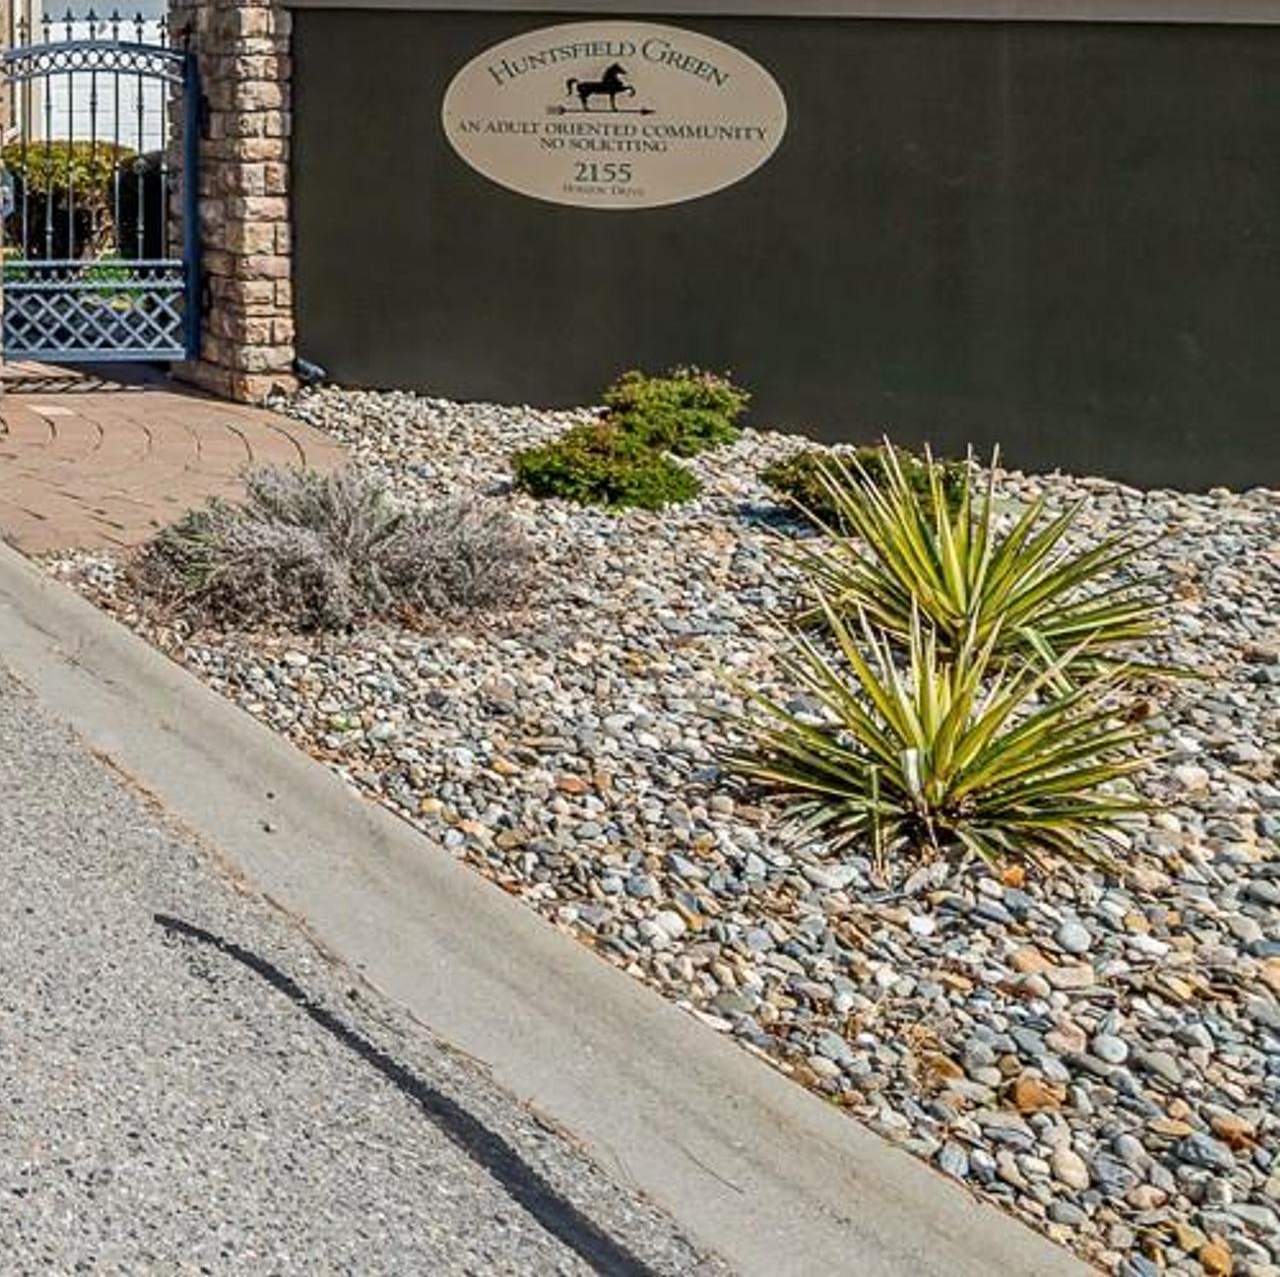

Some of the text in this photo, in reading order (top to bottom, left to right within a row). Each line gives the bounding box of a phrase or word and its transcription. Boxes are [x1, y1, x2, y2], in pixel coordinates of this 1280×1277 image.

[488, 37, 730, 88] HUNTSFIELD GREEN
[459, 121, 766, 140] AN ADULT ORIENTED COMMUNITY
[540, 137, 667, 153] NO SOLICITING
[574, 162, 632, 183] 2155
